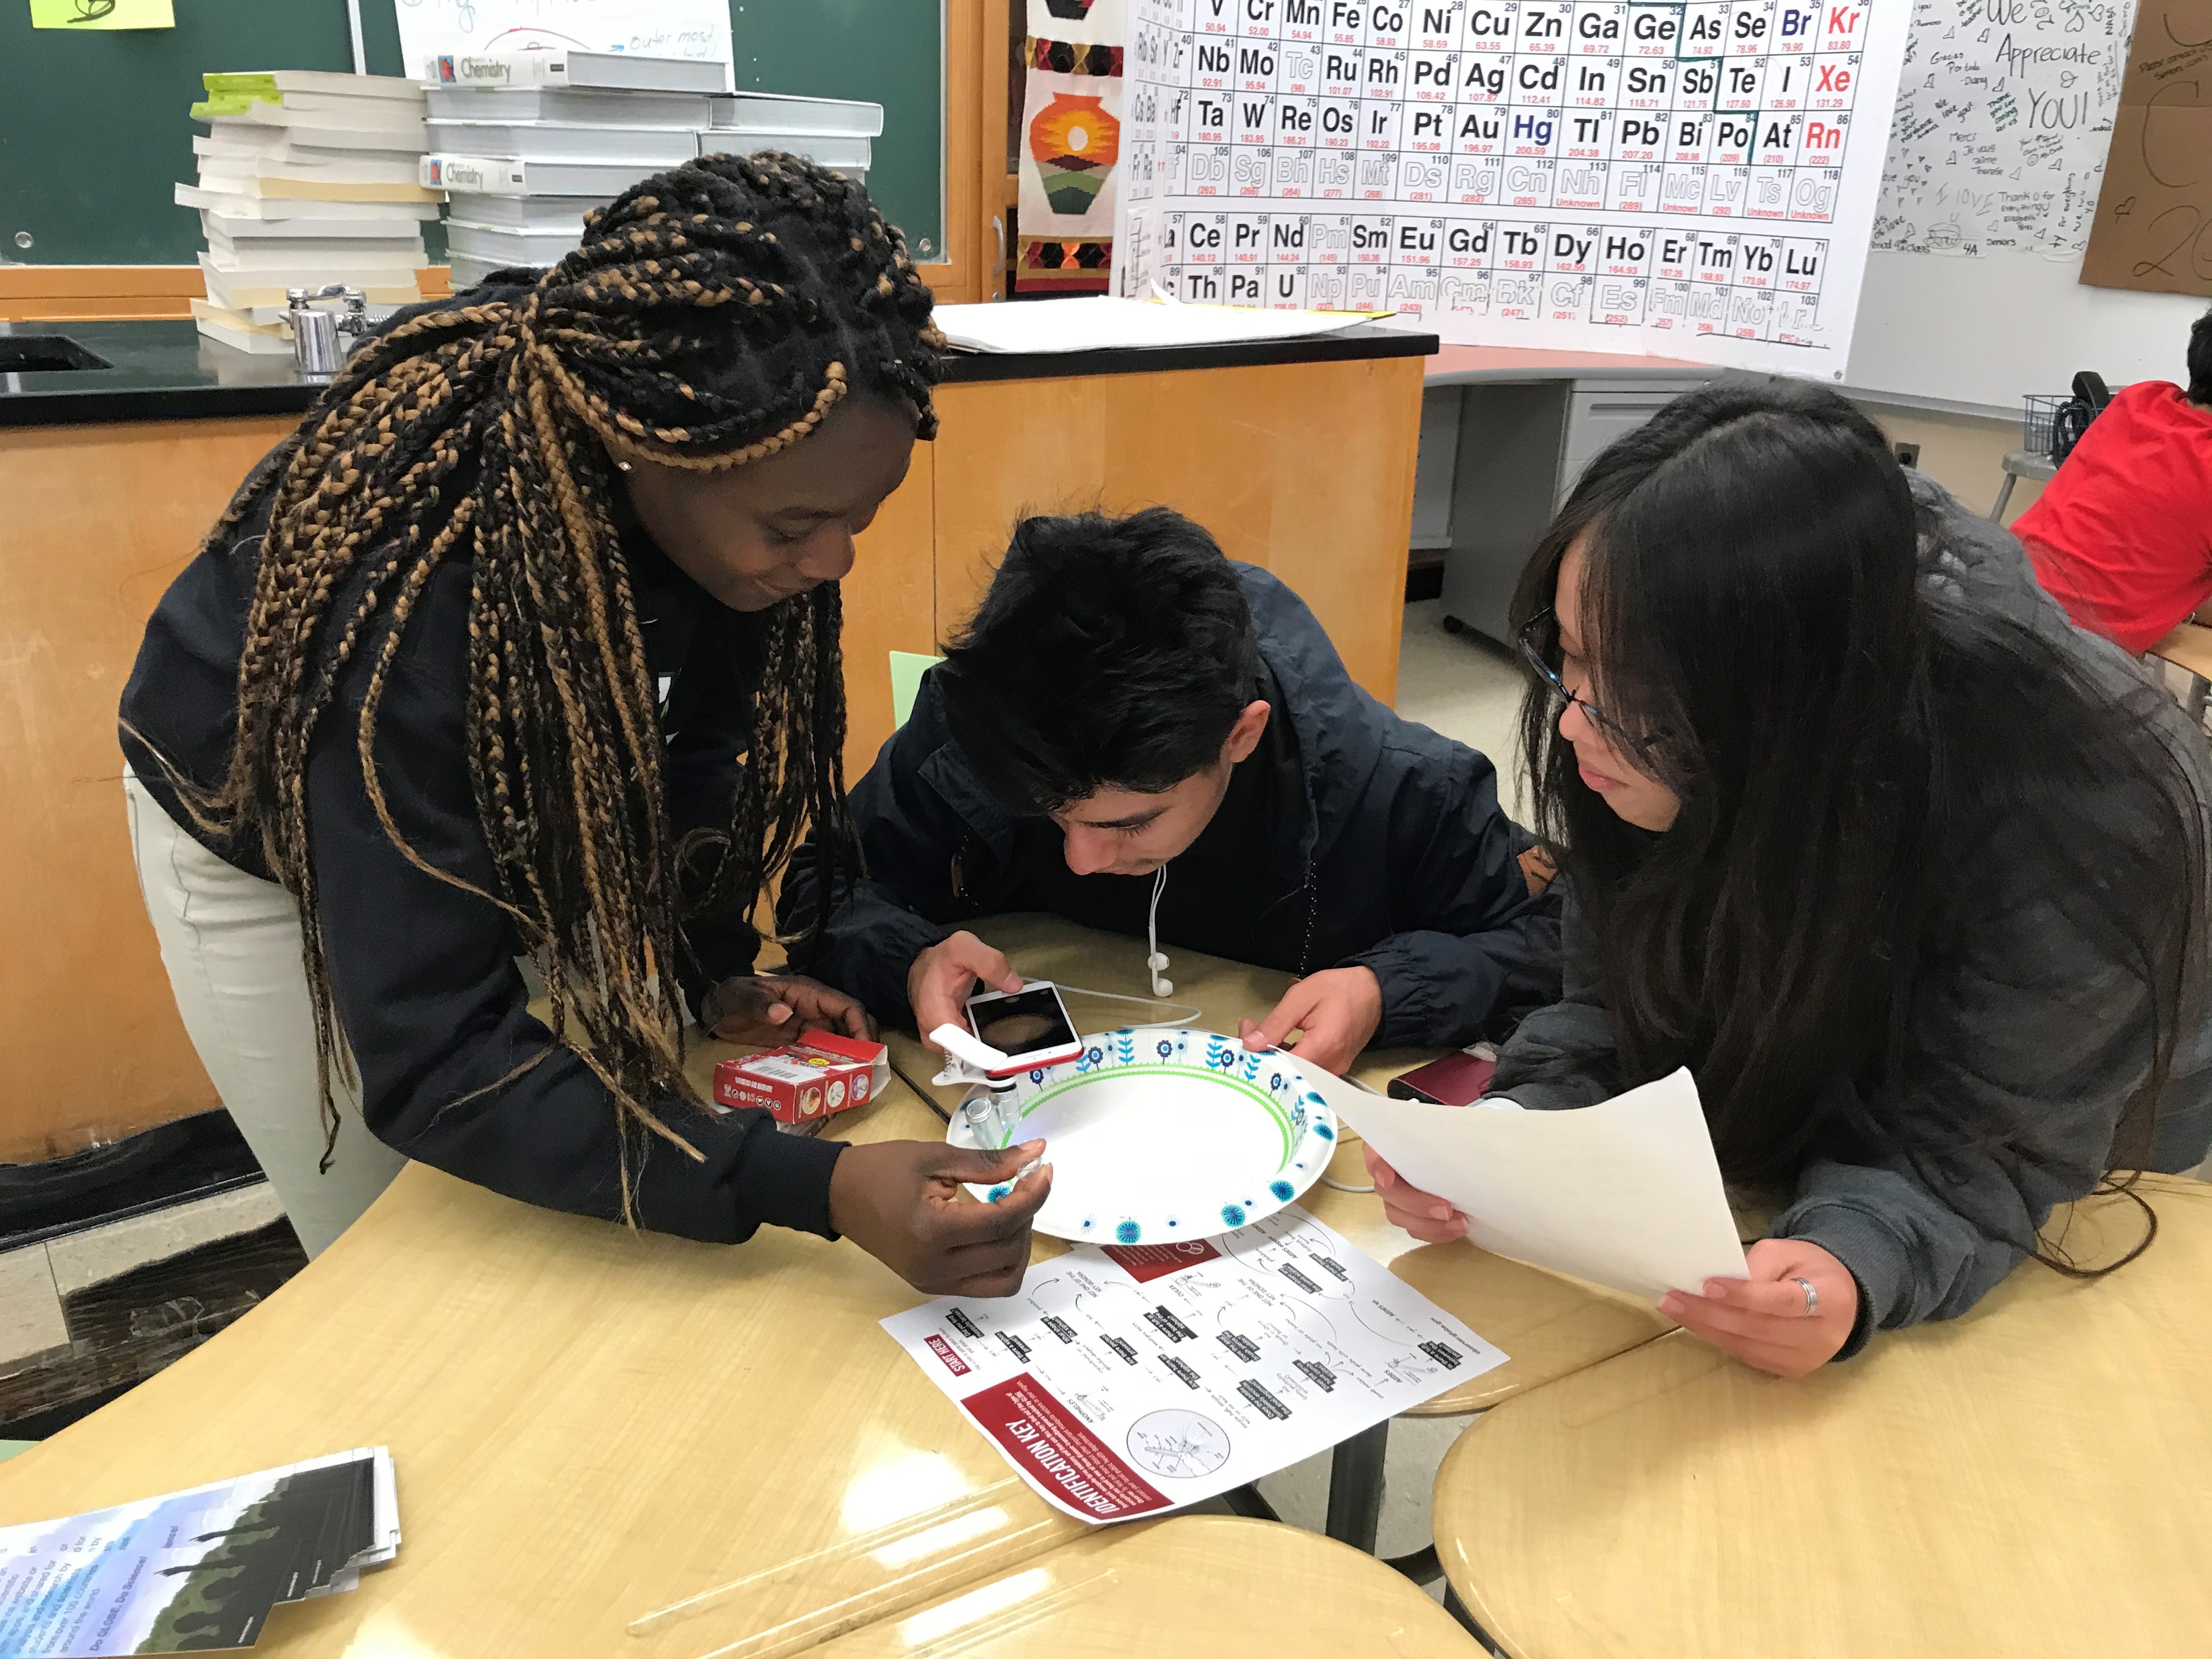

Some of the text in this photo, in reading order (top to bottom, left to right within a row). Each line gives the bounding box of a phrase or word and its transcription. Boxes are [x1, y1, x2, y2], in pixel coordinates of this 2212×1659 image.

[1505, 3, 1626, 14] 29 30 31
[1987, 0, 2027, 25] We
[1248, 0, 1274, 21] Cr
[1286, 0, 1319, 25] Mn
[1333, 2, 1359, 28] Fe
[1373, 5, 1403, 32] Co
[1423, 9, 1451, 34] Ni
[1471, 10, 1510, 36] Cu
[1525, 12, 1561, 37] Zn
[1579, 13, 1618, 39] Ga
[1634, 14, 1675, 40] Ge
[1689, 15, 1722, 40] As
[1735, 12, 1766, 38] Se
[1781, 9, 1812, 36] Br
[1829, 6, 1860, 33] Kr
[1530, 43, 1664, 54] 65.39 69.72 72.63
[1995, 33, 2101, 78] Appreciate
[461, 61, 511, 83] Chemistry
[1198, 45, 1229, 72] Nb
[1240, 48, 1274, 76] Mo
[1286, 52, 1313, 79] Tc
[1327, 55, 1357, 81] Ru
[1368, 58, 1398, 83] Rh
[1414, 61, 1451, 86] Pd
[1464, 63, 1505, 94] Ag
[1519, 65, 1558, 89] Cd
[1579, 66, 1605, 91] In
[1628, 67, 1666, 93] Sn
[1683, 68, 1713, 94] Sb
[1729, 68, 1756, 93] Te
[1782, 66, 1791, 92] I
[1815, 65, 1850, 92] Xe
[1662, 55, 1859, 69] 50 54
[1416, 92, 1658, 108] 106.42 118.71
[1494, 107, 1505, 116] 79
[1198, 101, 1223, 127] Ta
[1243, 103, 1265, 128] W
[1282, 105, 1311, 131] Re
[1323, 107, 1353, 133] Os
[1372, 110, 1387, 134] Ir
[1414, 112, 1442, 137] Pt
[1460, 115, 1499, 138] Au
[1514, 115, 1552, 146] Hg
[1574, 119, 1599, 143] Tl
[1621, 120, 1658, 145] Pb
[1679, 122, 1702, 146] Bi
[1717, 122, 1748, 148] Po
[1763, 122, 1792, 148] At
[1805, 122, 1841, 149] Rn
[1622, 150, 1829, 163] 207.20 (222)
[1192, 154, 1831, 212] Db Sg Bh Hs Ds Rg Cn Nh Fl Mc Lv Ts Og
[1823, 170, 1838, 180] 118
[1410, 192, 1600, 207] (281) Unknown
[1998, 191, 2030, 202] Thank
[1190, 223, 1817, 275] Ce Pr Nd Pm Sm Eu Gd Tb Dy Ho Er Tm Yb Lu
[1188, 275, 1638, 310] Th Pa U Es
[927, 1338, 951, 1355] HERE
[940, 1352, 968, 1372] START
[1004, 1418, 1041, 1442] KEY
[1025, 1439, 1120, 1514] IDENTIFICATION
[90, 1639, 103, 1651] Do
